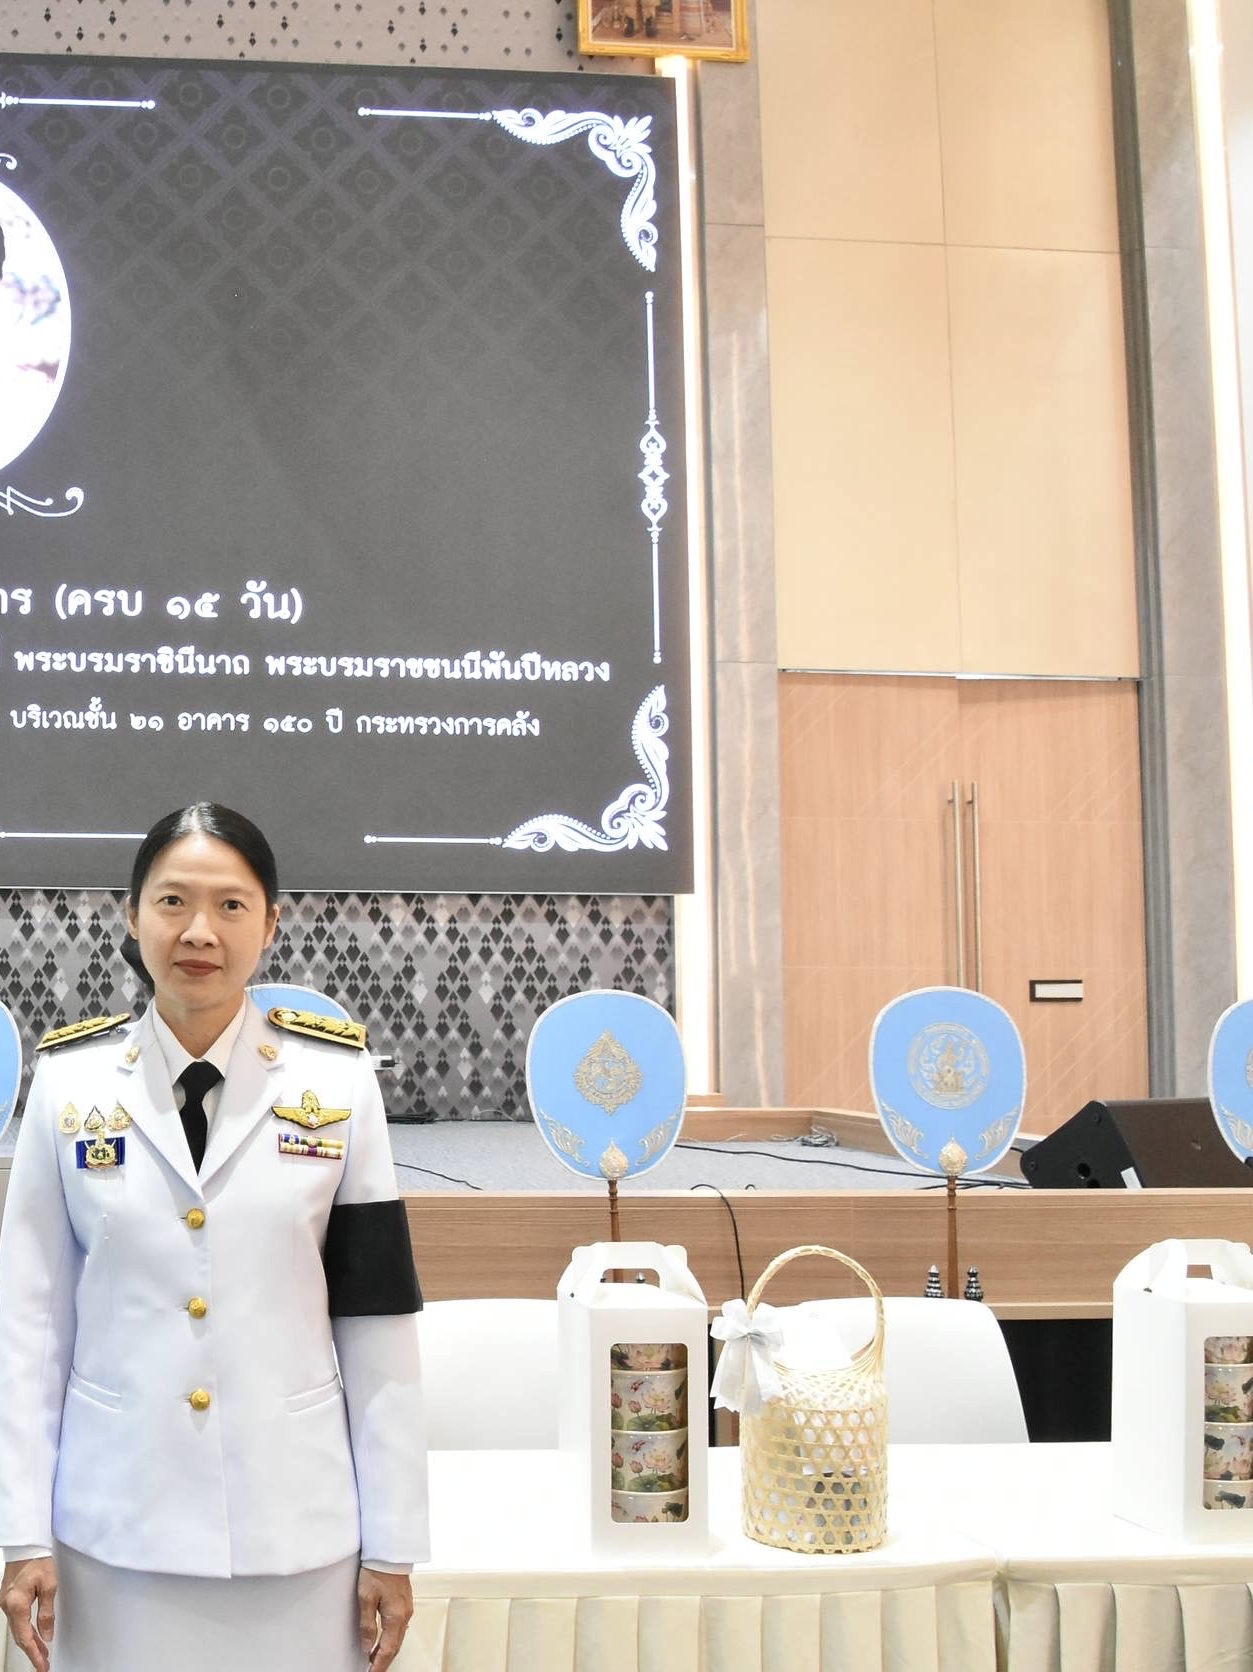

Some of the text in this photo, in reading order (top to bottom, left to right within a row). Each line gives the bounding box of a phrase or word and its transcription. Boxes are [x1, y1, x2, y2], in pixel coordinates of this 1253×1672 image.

[54, 583, 143, 620] (ครบ
[166, 592, 221, 620] ๑๕
[240, 579, 303, 625] วัน)
[13, 645, 250, 675] พระบรมราชินีนาถ
[264, 650, 610, 682] พระบรมราชชนนีพันปีหลวง
[9, 696, 118, 730] บริเวณชั้น
[129, 713, 164, 732] ๒๑
[177, 711, 250, 732] อาคาร
[263, 714, 313, 734] ๑๕๐
[325, 707, 343, 734] ปี
[356, 710, 540, 737] กระทรวงการคลัง
